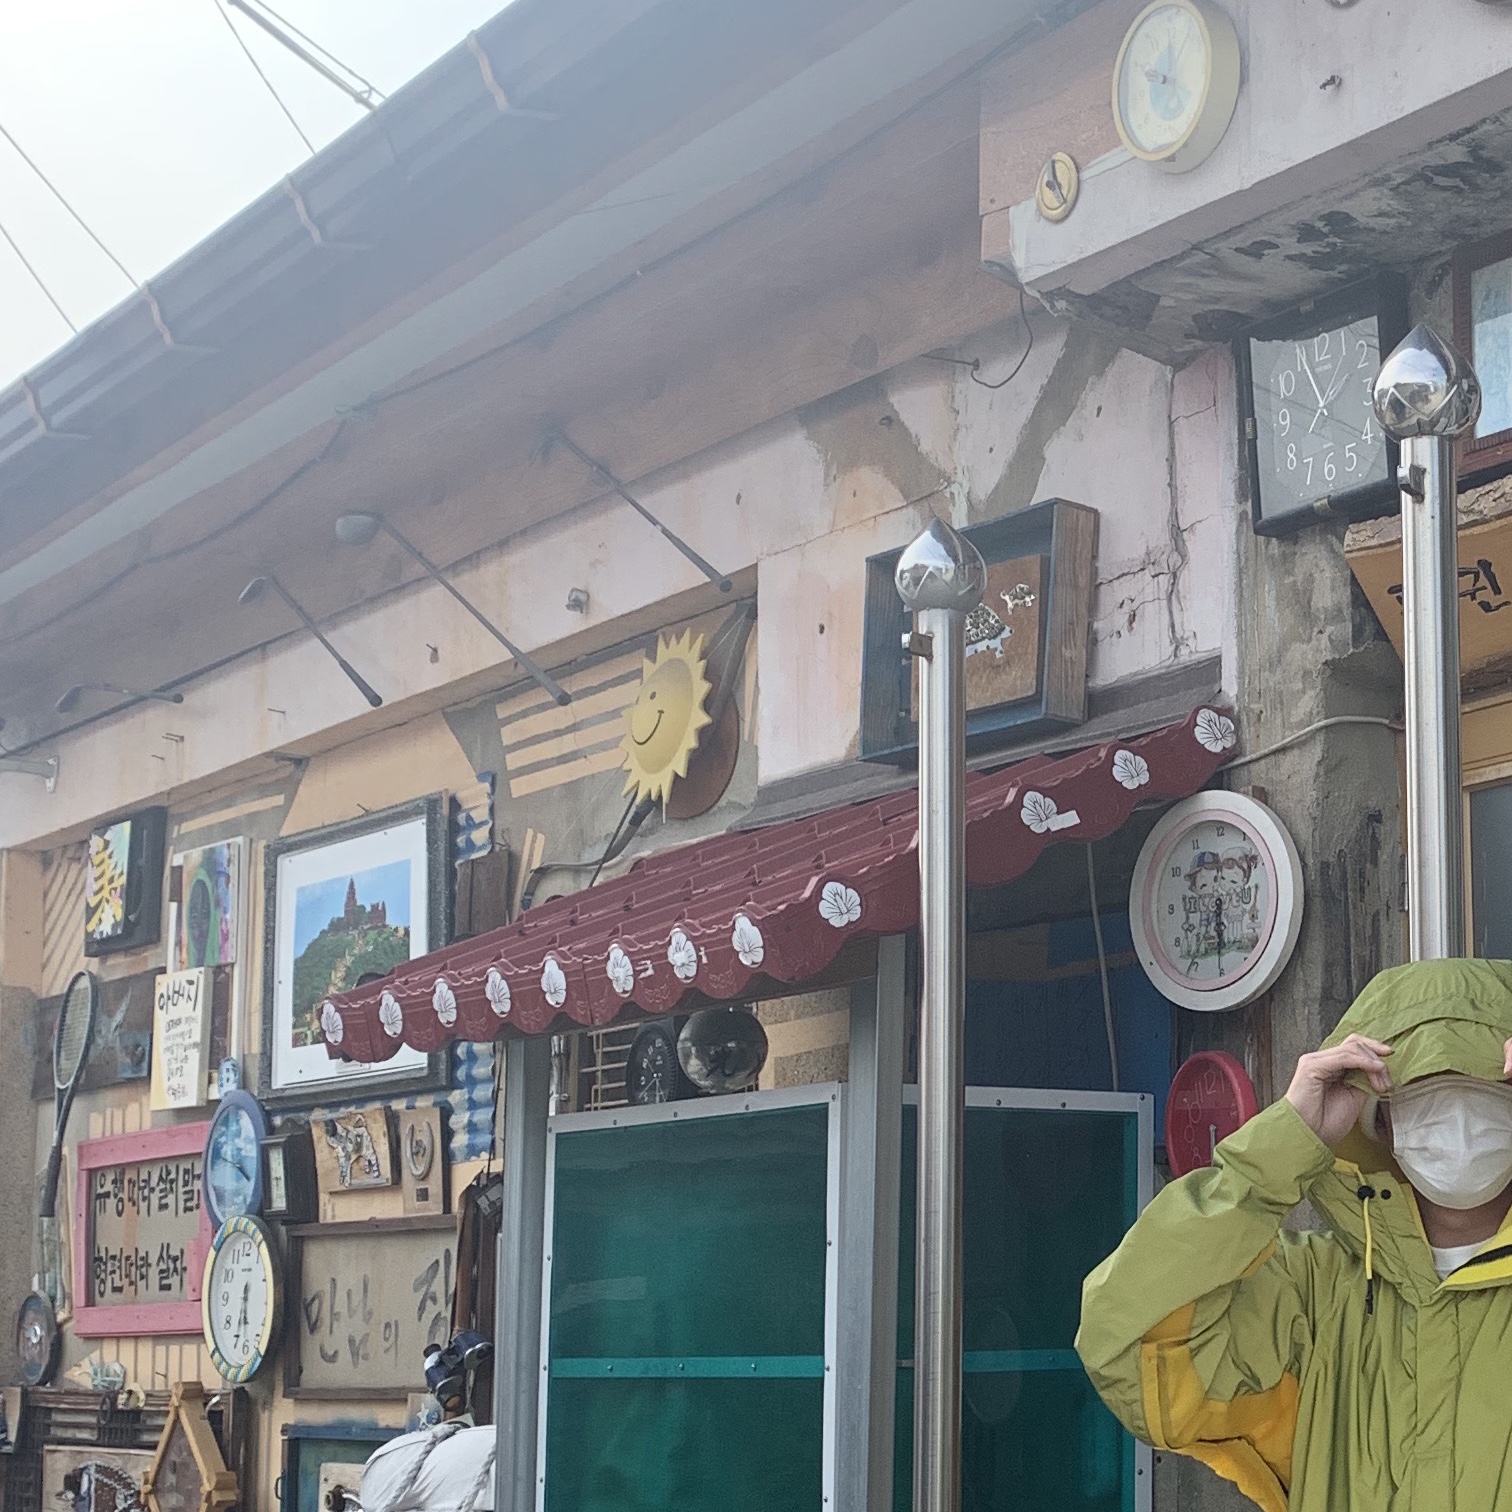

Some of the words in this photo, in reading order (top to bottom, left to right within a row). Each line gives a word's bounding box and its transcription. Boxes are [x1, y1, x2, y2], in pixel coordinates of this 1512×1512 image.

[1314, 333, 1331, 362] 12
[1341, 330, 1346, 356] 1
[1356, 340, 1369, 369] 2
[1279, 370, 1295, 399] 10
[1279, 409, 1290, 437] 9
[1362, 417, 1375, 444] 4
[1287, 443, 1297, 470] 8
[1324, 452, 1336, 481] 6
[1345, 442, 1357, 472] 5
[1303, 457, 1314, 485] 7
[1387, 559, 1511, 613] 귄
[1192, 839, 1200, 850] 11
[1216, 826, 1225, 837] 12
[1171, 866, 1181, 877] 10
[156, 1162, 201, 1217] 살지말
[231, 1249, 240, 1264] 11
[242, 1241, 251, 1257] 12
[156, 1242, 188, 1293] 살자
[223, 1268, 234, 1283] 10
[303, 1273, 399, 1368] 만남의
